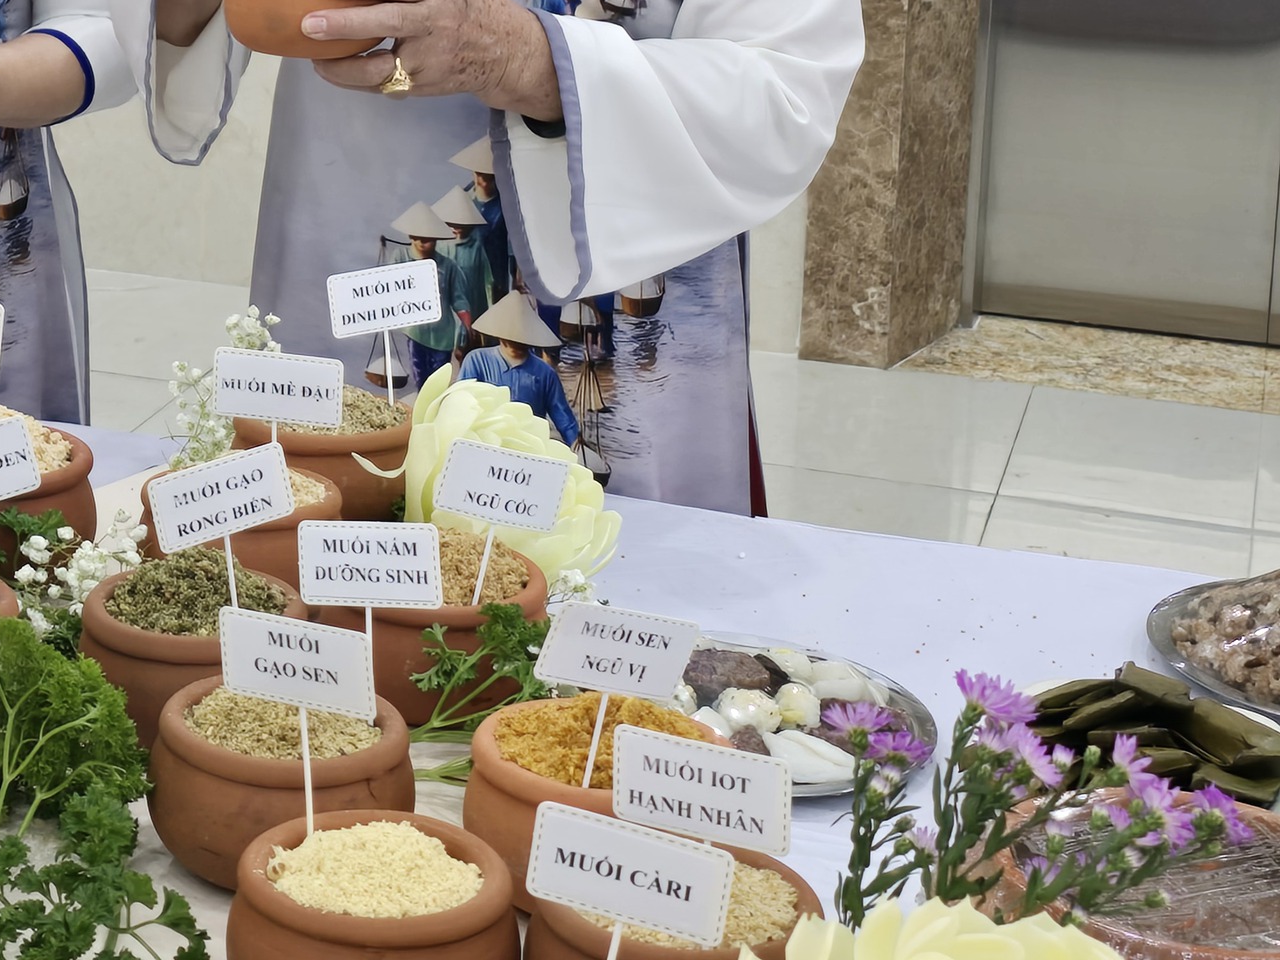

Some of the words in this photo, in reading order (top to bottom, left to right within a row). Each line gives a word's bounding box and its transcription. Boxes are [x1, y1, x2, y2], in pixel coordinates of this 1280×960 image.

[225, 467, 264, 490] GẠO
[176, 510, 228, 537] RONG
[385, 568, 429, 585] SINH
[635, 631, 672, 651] SEN
[254, 657, 296, 679] GẠO
[302, 666, 339, 686] SEN
[711, 771, 752, 794] IOT
[629, 789, 692, 819] HẠNH
[699, 805, 764, 835] NHÂN
